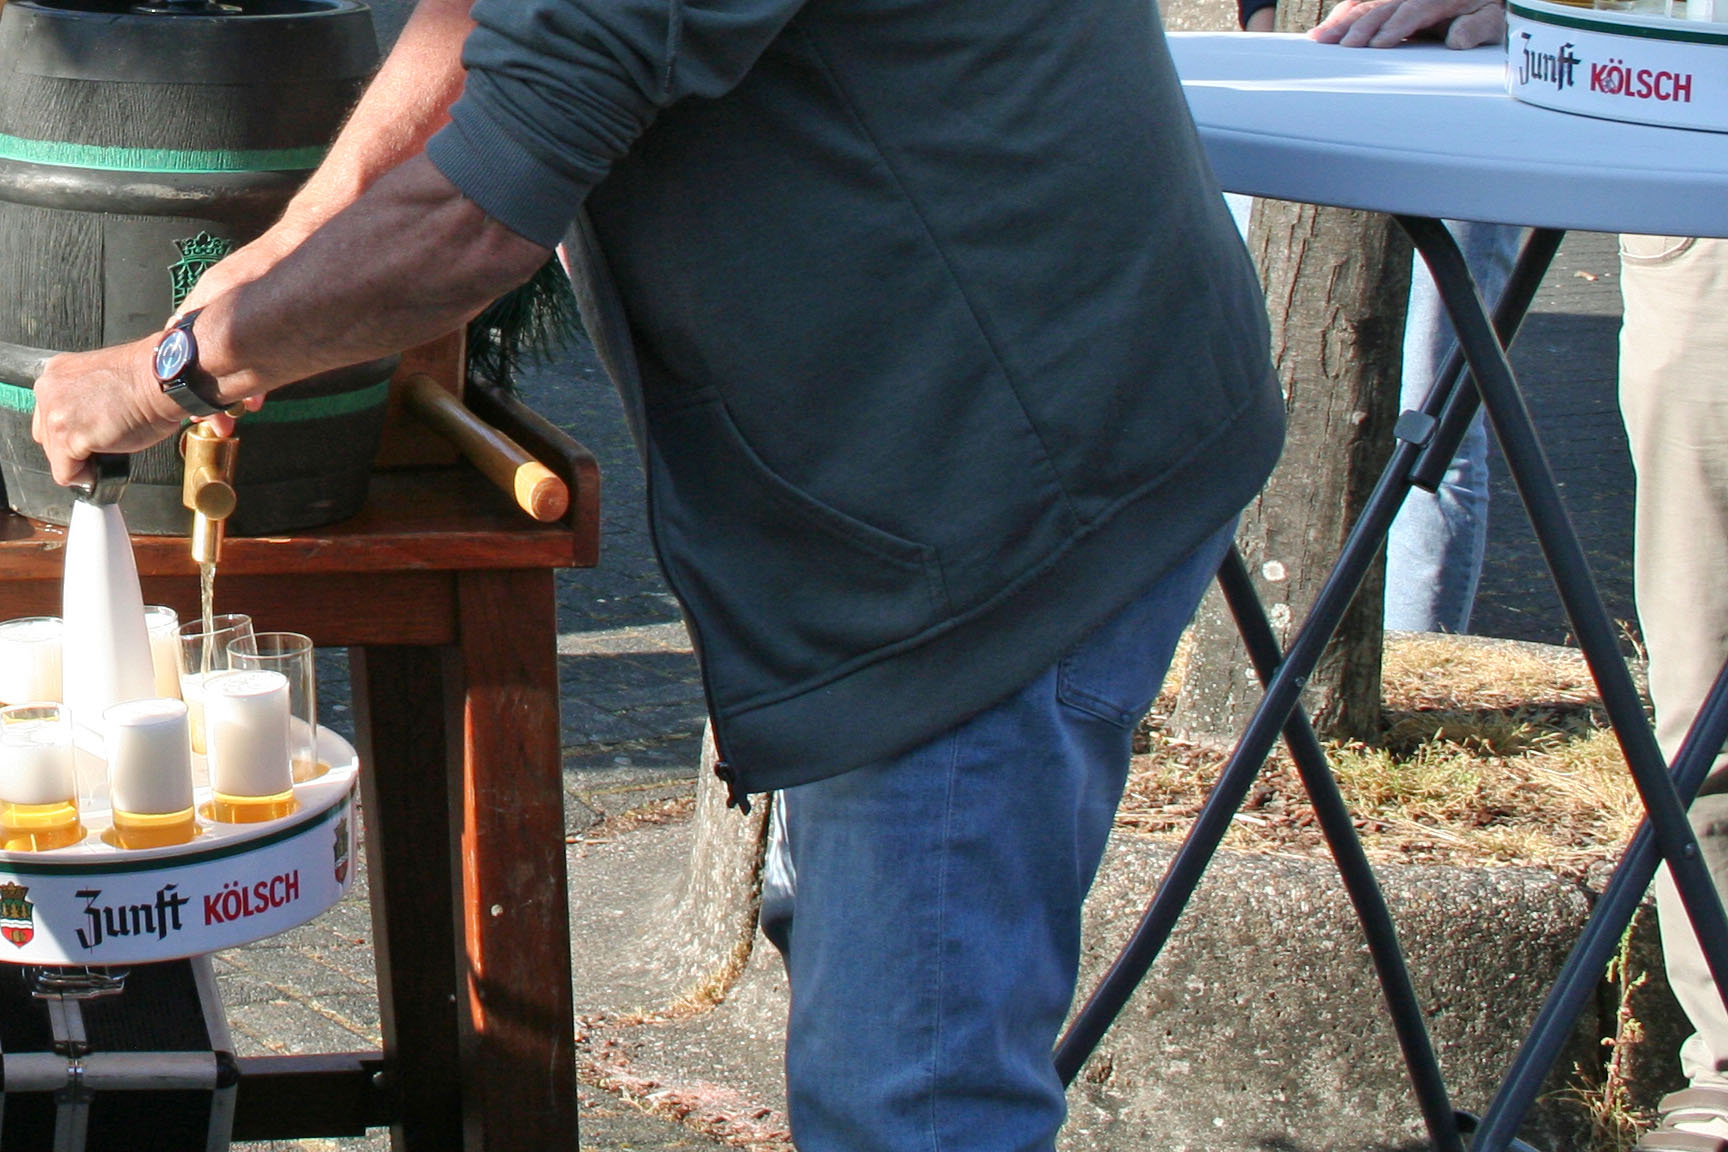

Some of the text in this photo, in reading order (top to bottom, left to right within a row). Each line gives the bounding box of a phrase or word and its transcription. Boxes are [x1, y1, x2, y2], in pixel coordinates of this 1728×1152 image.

[1519, 31, 1693, 103] Zunft KÖLSCH
[75, 870, 300, 951] Zunft KÖLSCH
